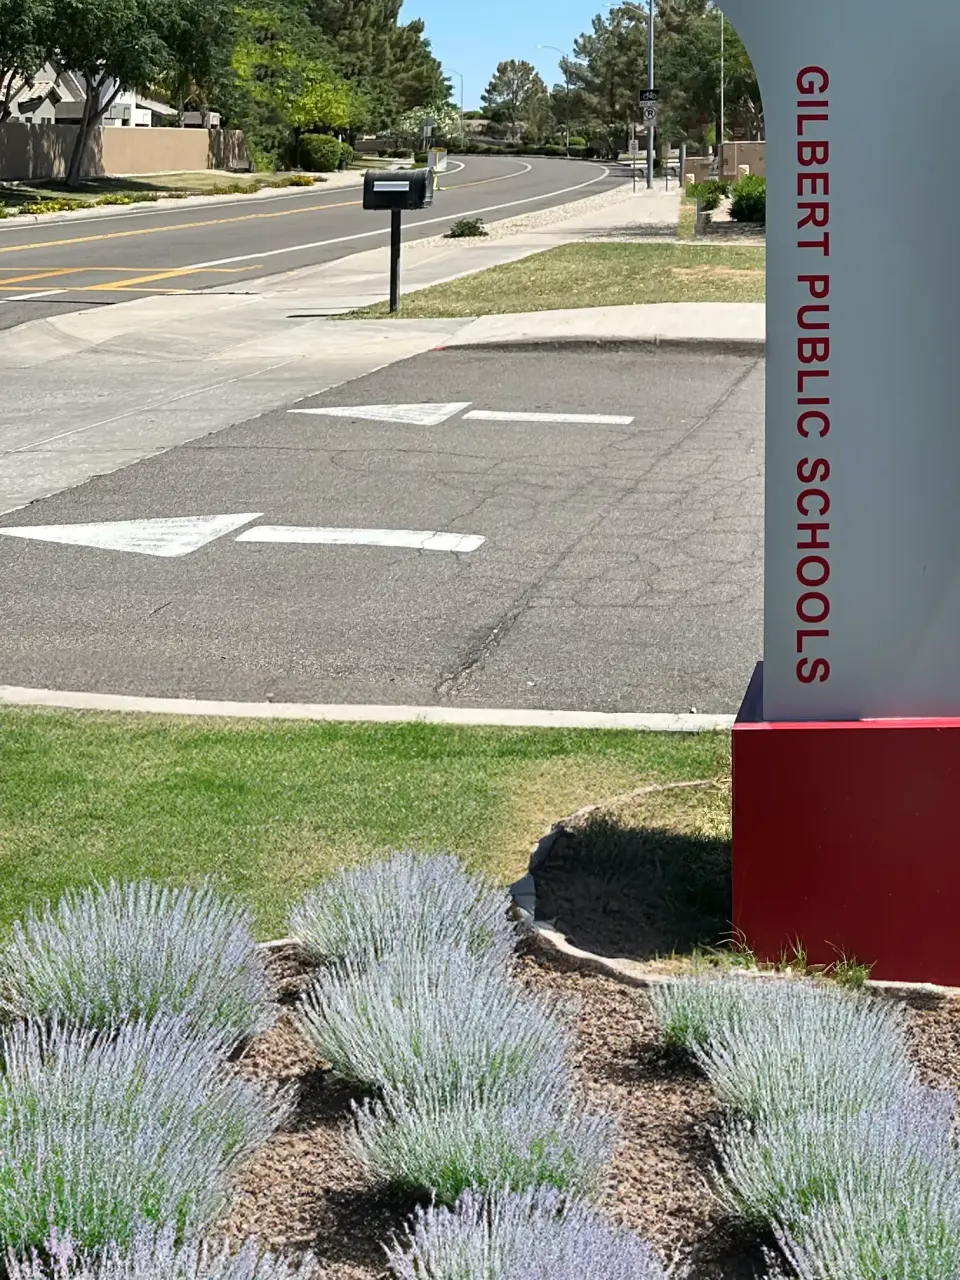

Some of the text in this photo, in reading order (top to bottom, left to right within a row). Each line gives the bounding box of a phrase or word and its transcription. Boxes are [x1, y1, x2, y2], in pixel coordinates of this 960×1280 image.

[796, 65, 830, 684] GILBERT PUBLIC SCHOOLS
